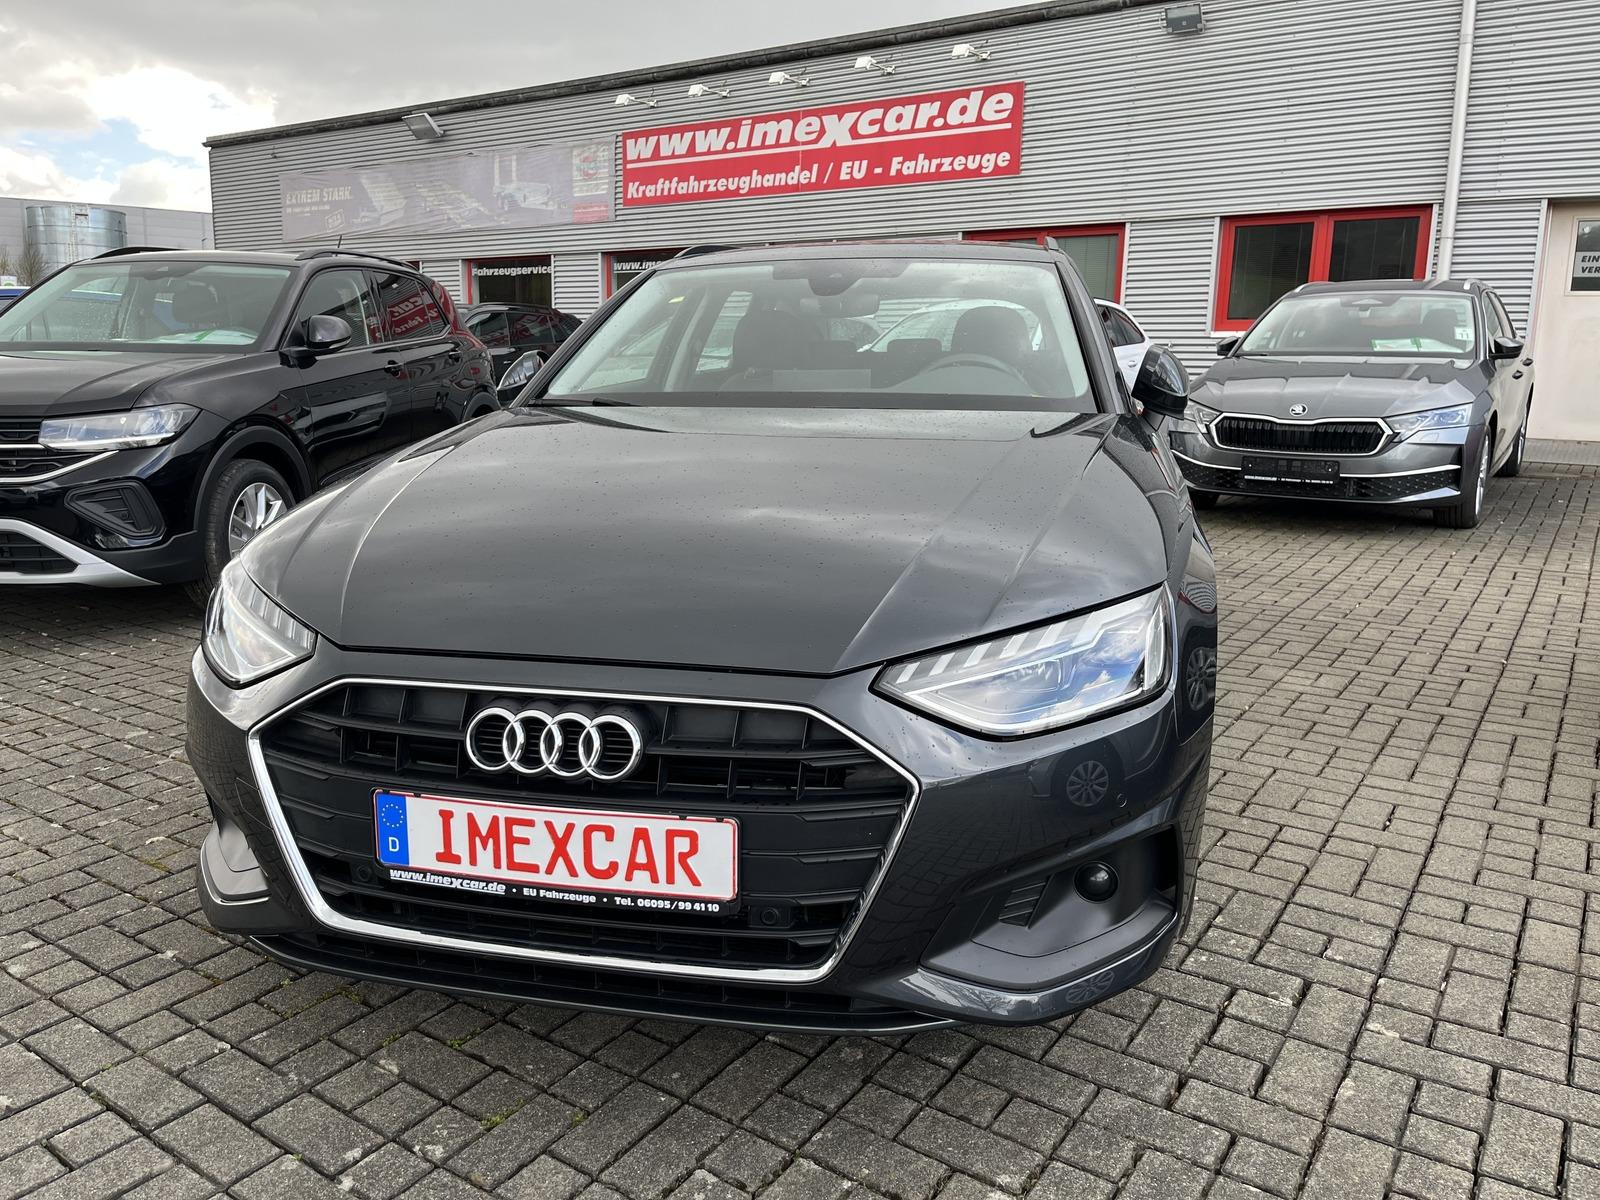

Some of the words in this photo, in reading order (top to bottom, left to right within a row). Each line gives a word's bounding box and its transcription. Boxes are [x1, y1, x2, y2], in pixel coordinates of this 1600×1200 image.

[626, 90, 1014, 160] www.imexcar.de
[627, 163, 818, 200] Kraftfahrzeughandel
[839, 160, 868, 180] EU
[889, 151, 1011, 176] Fahrzeuge
[471, 265, 553, 276] Fahrzeugservice
[388, 836, 400, 852] D
[435, 808, 702, 887] IMEXCAR
[389, 869, 506, 894] www.imexcar.de
[523, 888, 537, 896] EU
[540, 889, 597, 903] Fahrzeuge
[614, 897, 635, 906] Tel.
